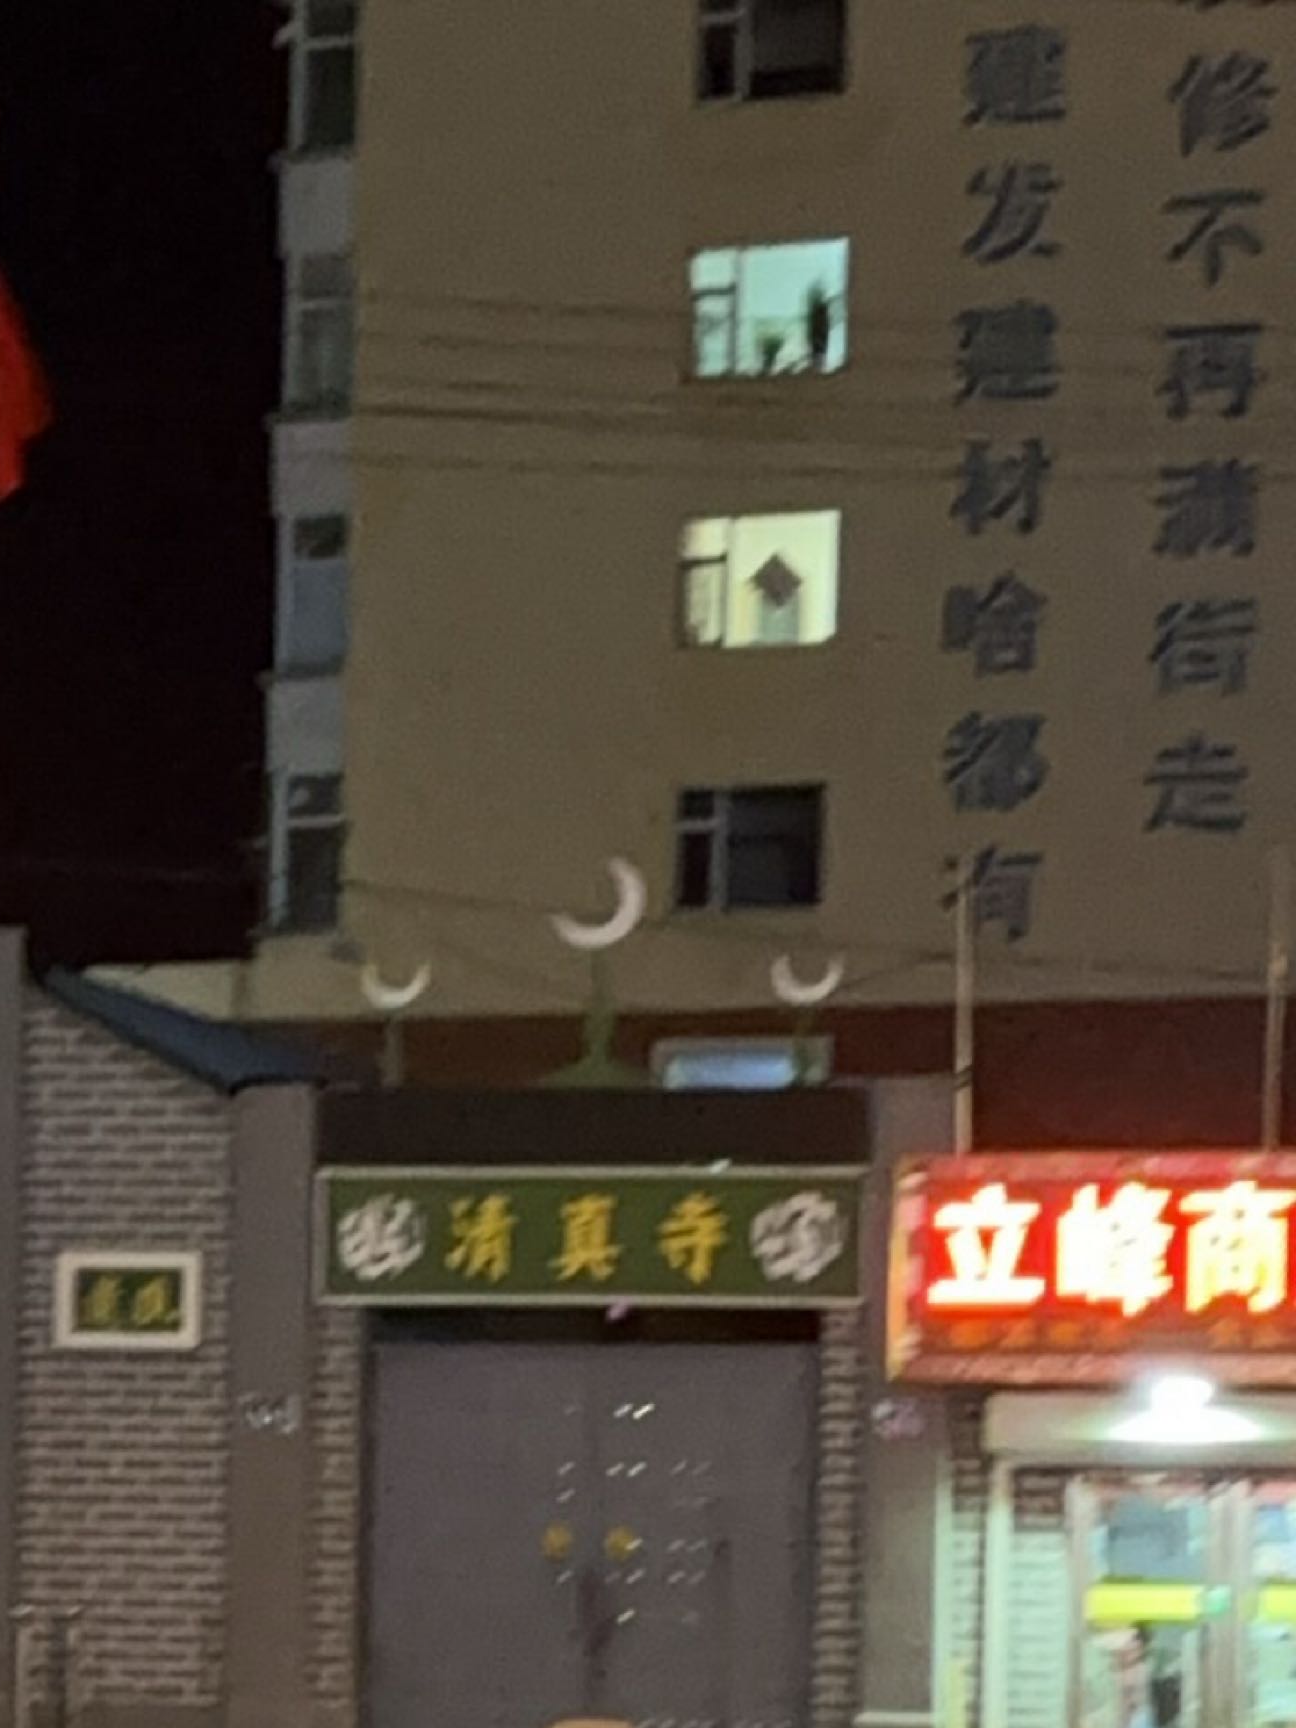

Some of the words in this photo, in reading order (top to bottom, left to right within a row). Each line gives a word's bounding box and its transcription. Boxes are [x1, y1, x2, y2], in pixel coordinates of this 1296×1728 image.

[444, 1193, 728, 1284] 清真寺
[926, 1181, 1296, 1317] 立峰商
